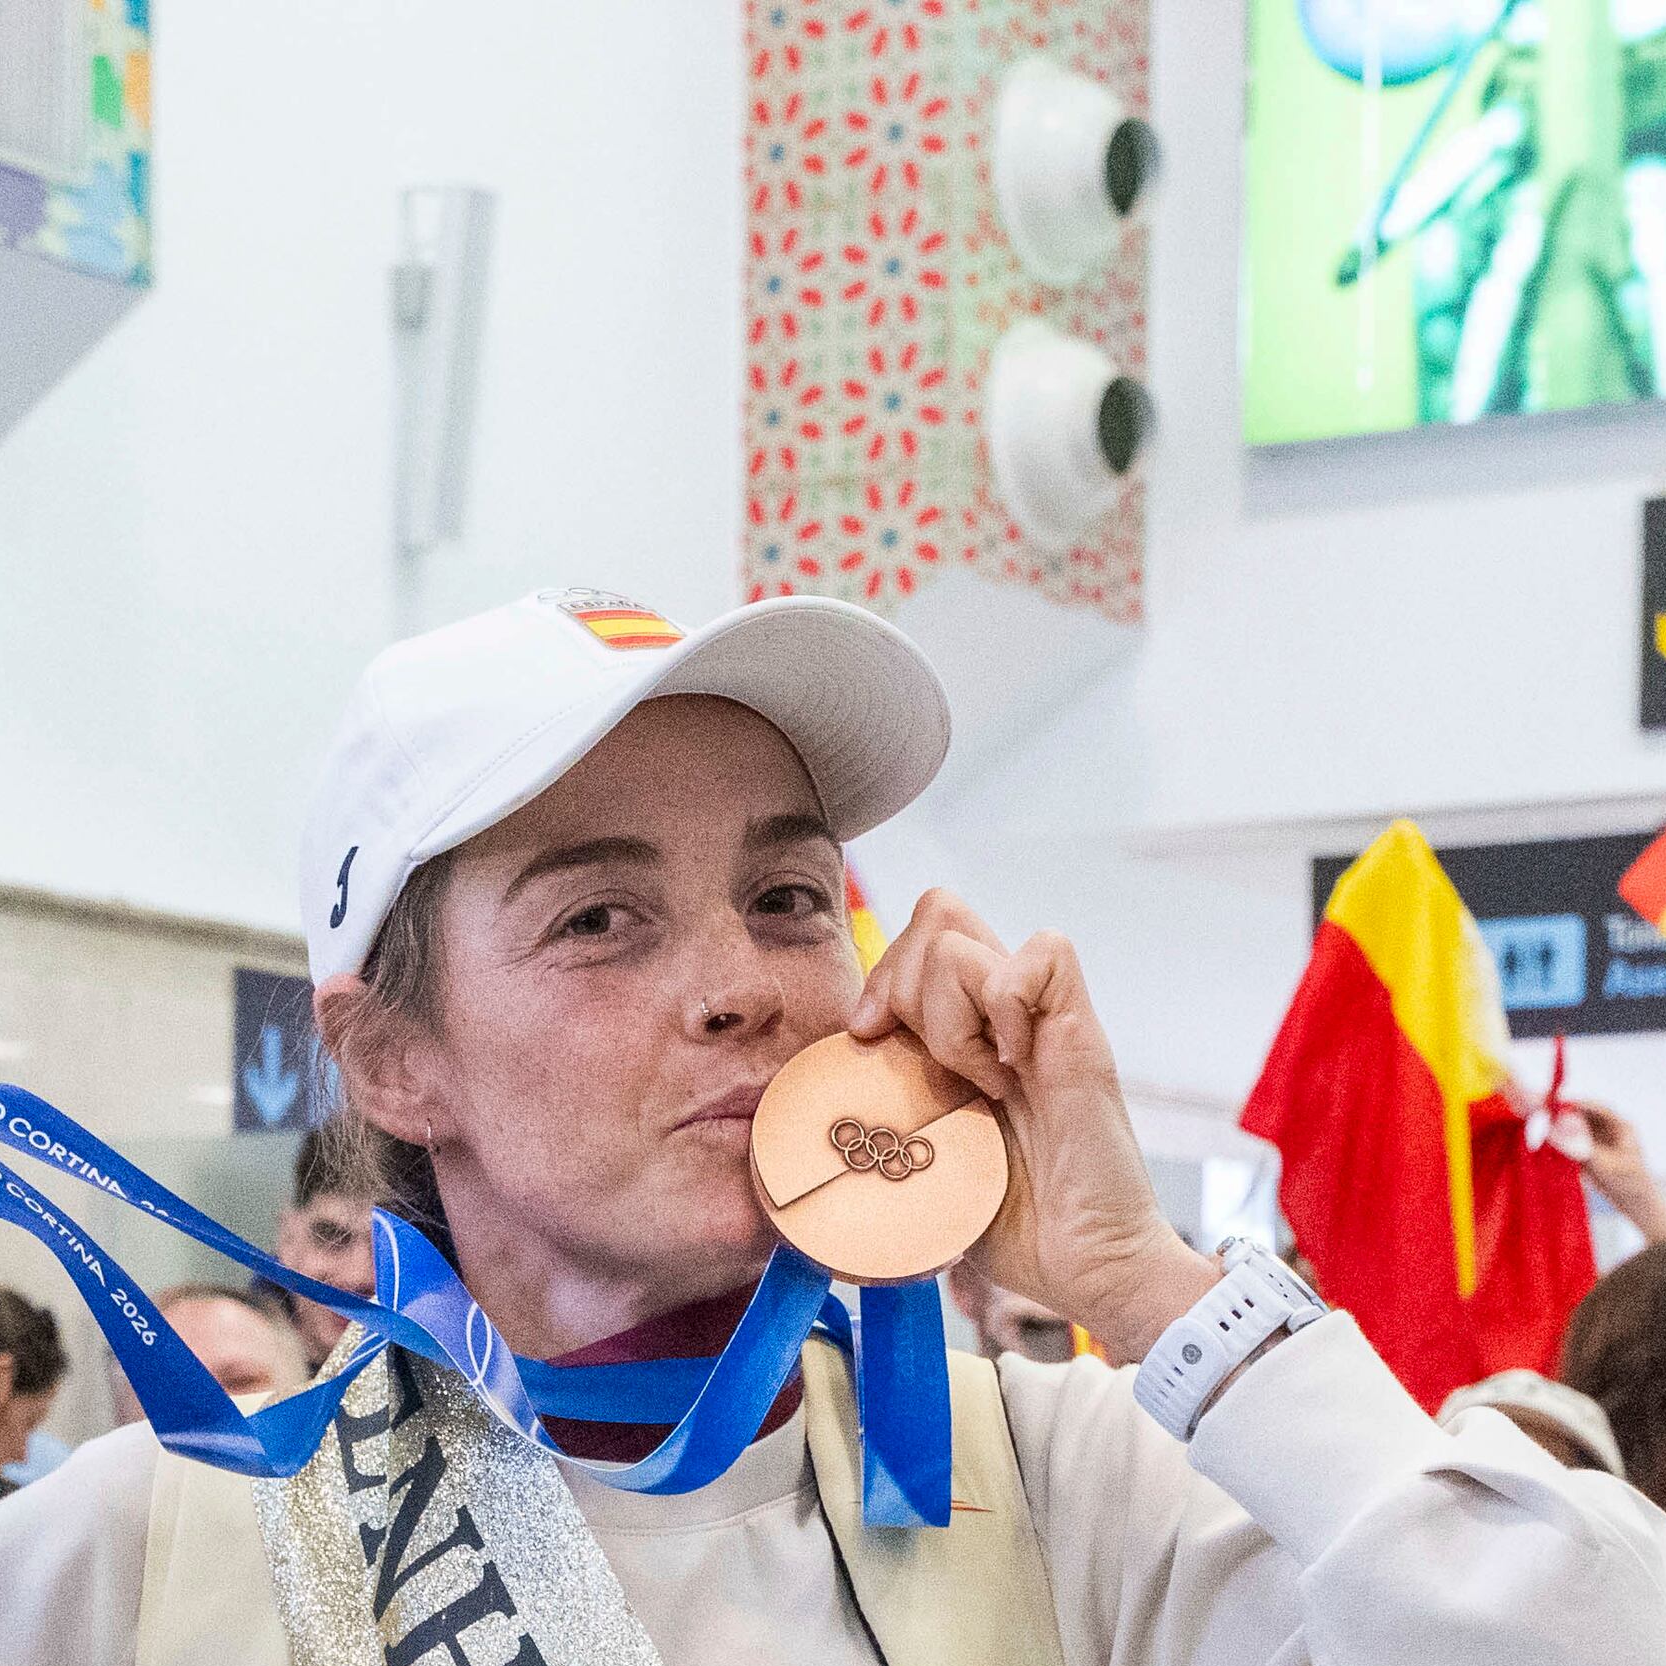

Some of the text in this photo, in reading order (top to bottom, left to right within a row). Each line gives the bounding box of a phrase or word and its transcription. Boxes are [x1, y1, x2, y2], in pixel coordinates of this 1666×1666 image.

[9, 1117, 128, 1199] CORTINA
[6, 1181, 106, 1287] CORTINA
[110, 1288, 158, 1346] 2026
